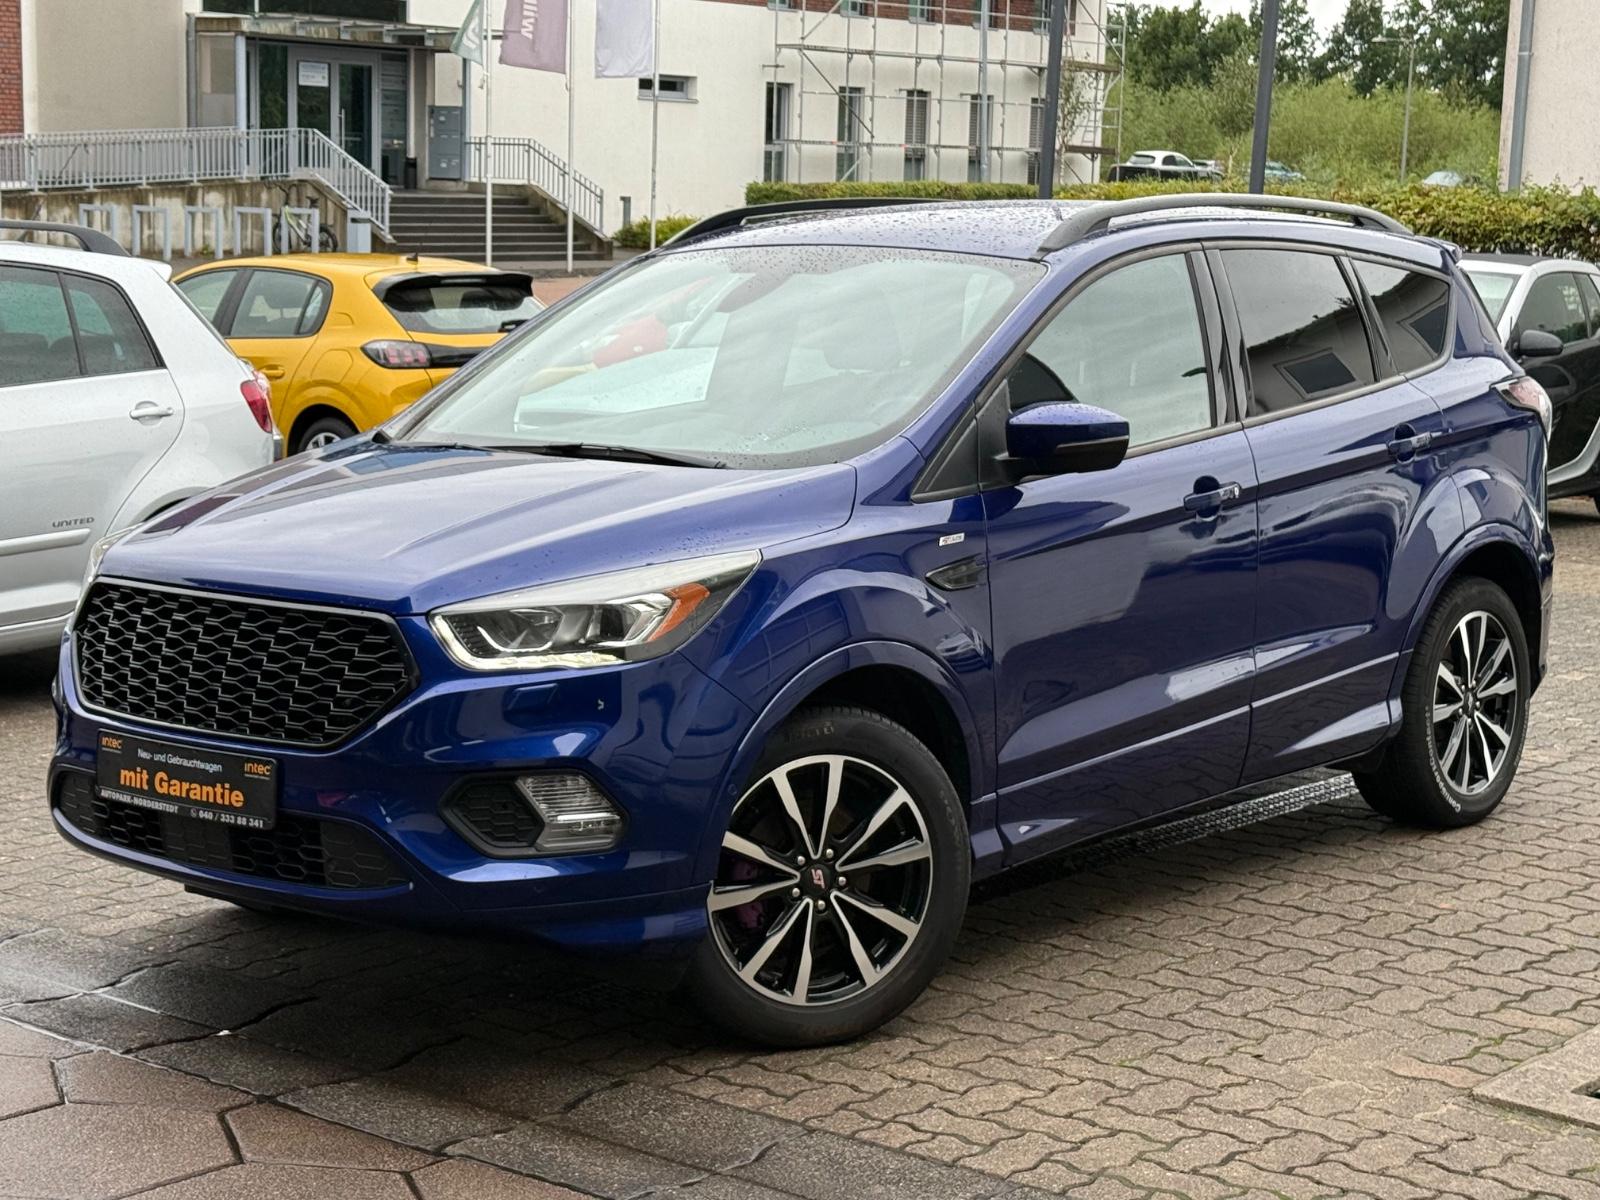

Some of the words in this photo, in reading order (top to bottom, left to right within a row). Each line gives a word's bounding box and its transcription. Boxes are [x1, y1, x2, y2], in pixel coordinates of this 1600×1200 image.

[52, 517, 95, 528] UNITED
[102, 737, 122, 749] intec
[138, 748, 152, 760] Neu-
[153, 752, 166, 762] und
[167, 754, 222, 773] Gebrauchtwagen
[245, 762, 271, 775] intec
[120, 767, 149, 790] mit
[154, 771, 244, 807] Garantie
[199, 810, 213, 820] 040
[220, 813, 235, 824] 333
[237, 816, 247, 826] 88
[249, 818, 264, 829] 341
